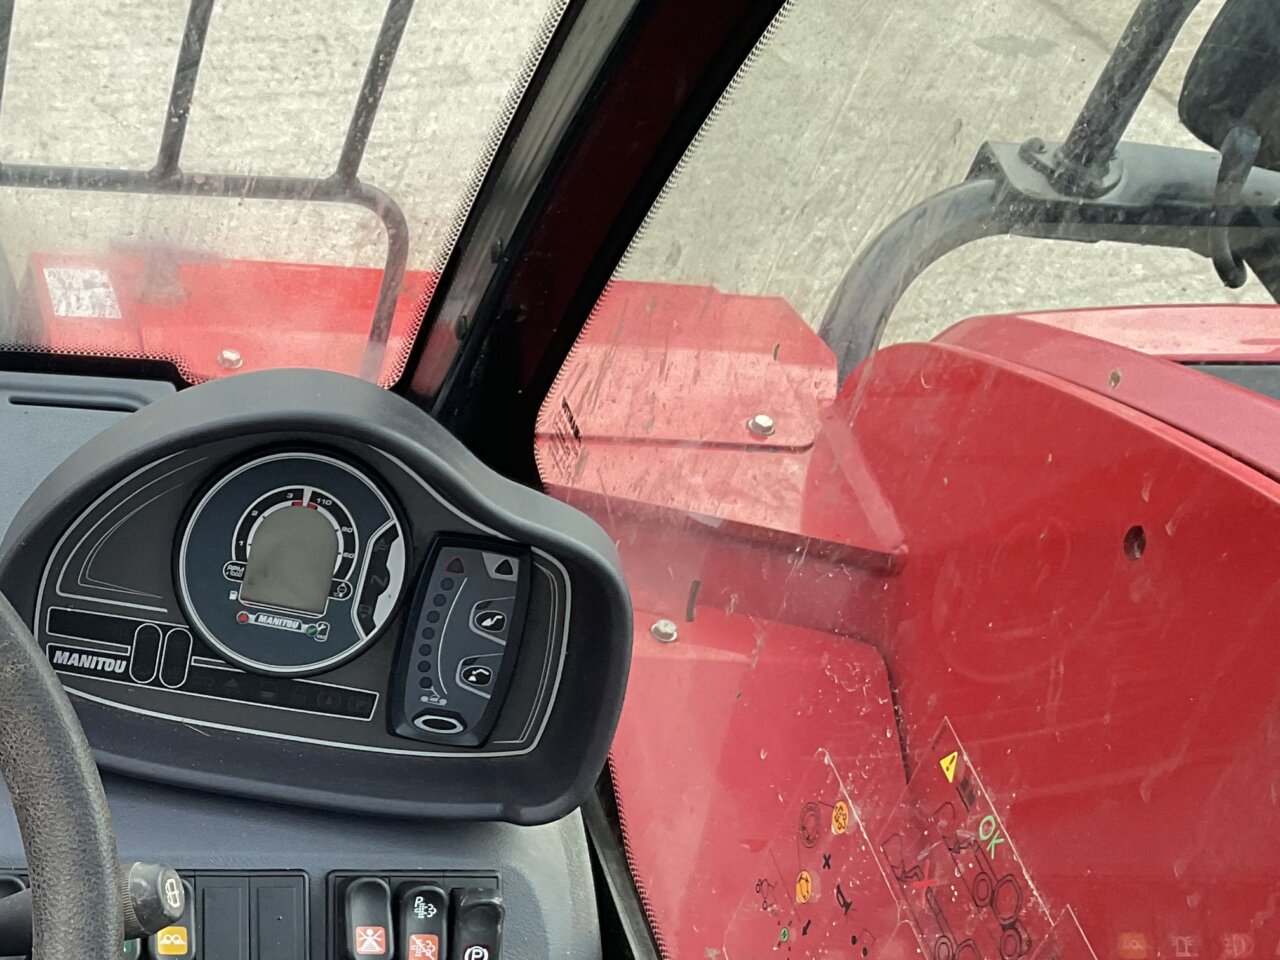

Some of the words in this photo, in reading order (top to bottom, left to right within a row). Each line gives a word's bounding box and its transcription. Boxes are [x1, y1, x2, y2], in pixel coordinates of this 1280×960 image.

[316, 498, 332, 506] 110
[226, 565, 245, 573] RPM
[257, 615, 300, 629] MANITOU
[53, 650, 127, 673] MANITOU
[979, 815, 1004, 860] OK
